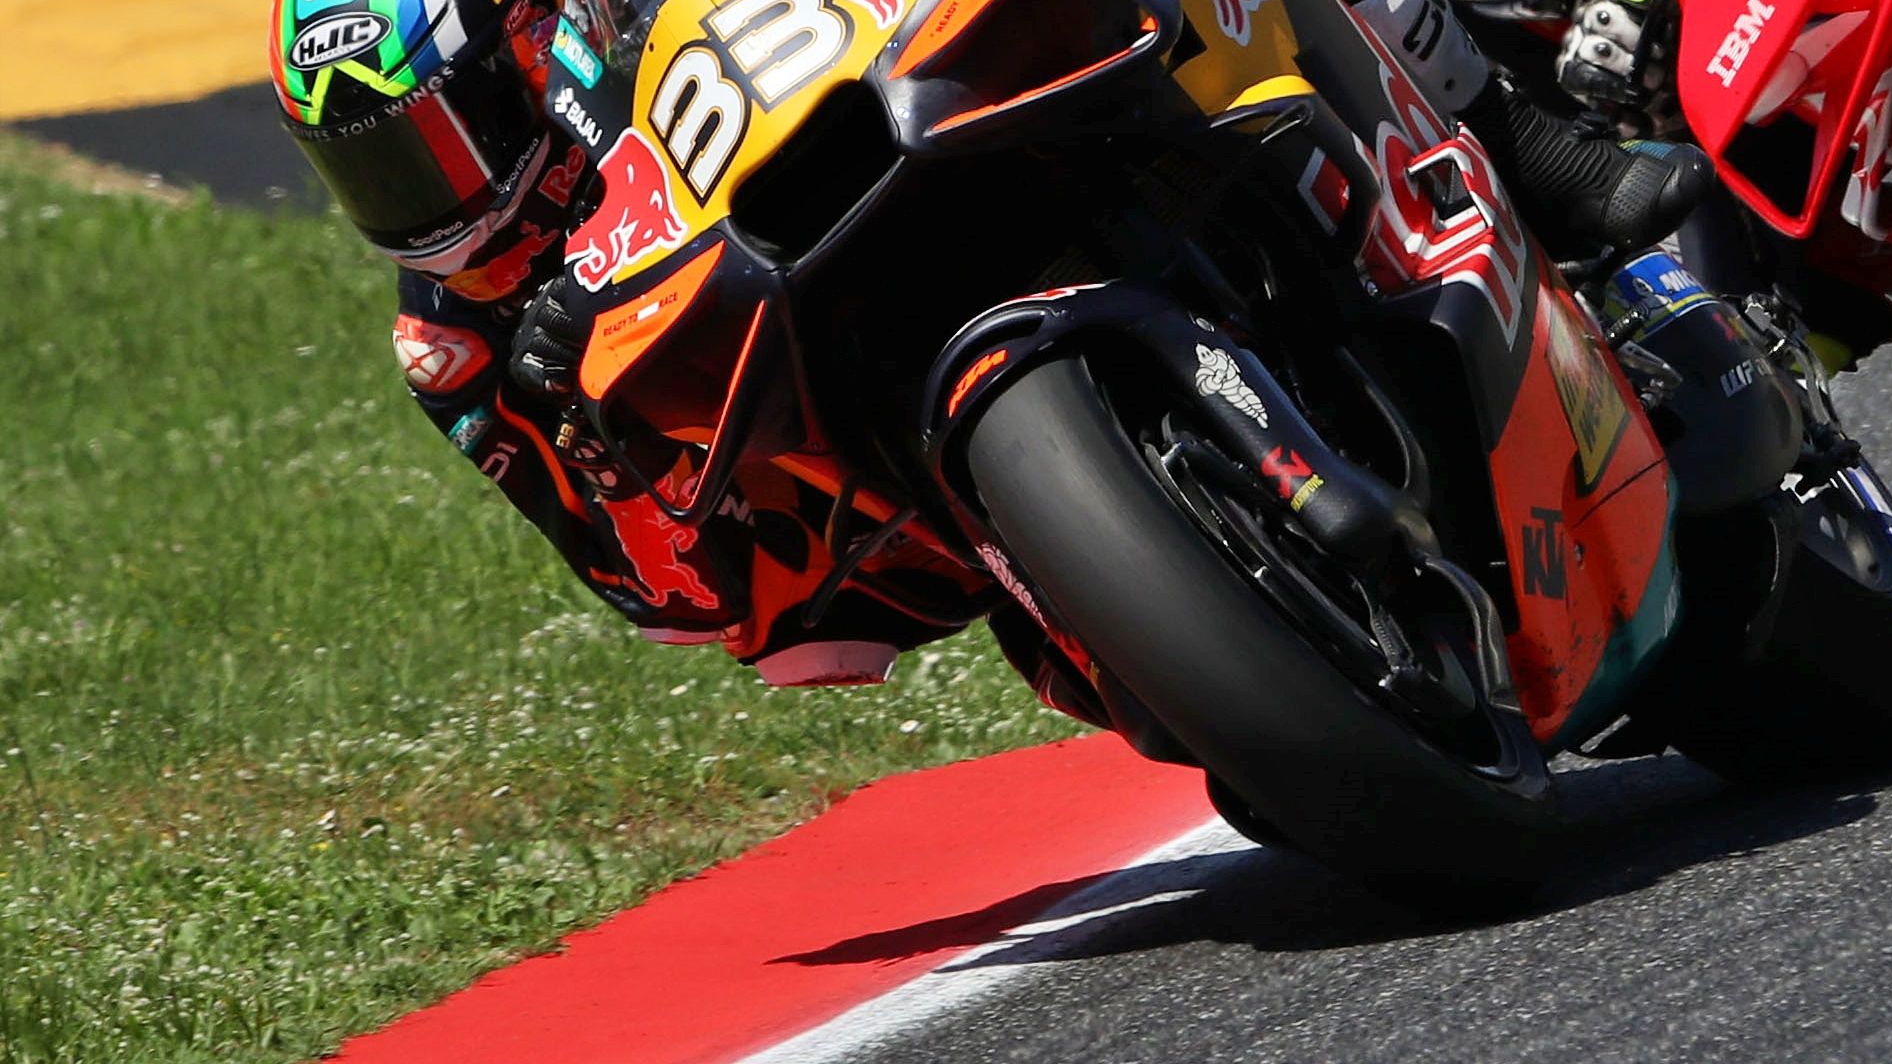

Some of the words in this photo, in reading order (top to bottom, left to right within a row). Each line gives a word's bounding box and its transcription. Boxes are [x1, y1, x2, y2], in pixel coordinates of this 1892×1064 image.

[299, 19, 371, 63] HJC
[338, 116, 377, 138] YOU
[384, 66, 455, 118] WINGS
[565, 101, 603, 147] BAJAJ
[948, 349, 1008, 418] KTM
[1522, 506, 1567, 601] KTM
